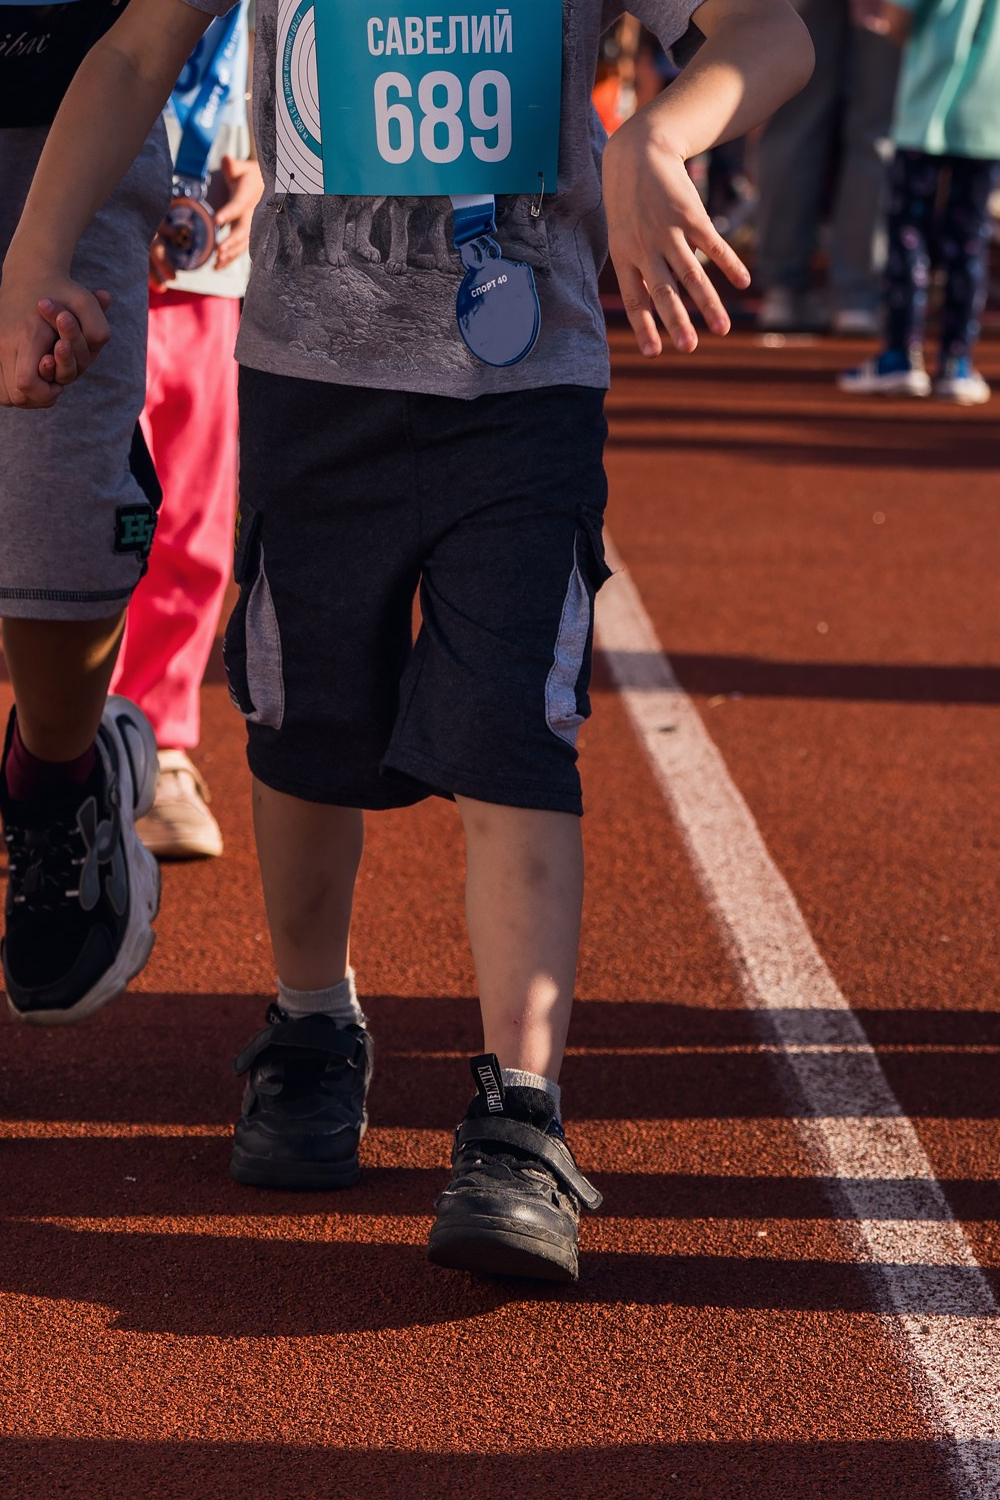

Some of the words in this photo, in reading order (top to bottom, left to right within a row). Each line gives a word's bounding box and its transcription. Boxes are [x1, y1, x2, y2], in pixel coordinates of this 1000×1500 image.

[367, 9, 513, 56] САВЕЛИЙ
[295, 116, 305, 133] 300
[374, 70, 513, 165] 689
[471, 280, 496, 298] СПОРТ
[497, 274, 508, 285] 40
